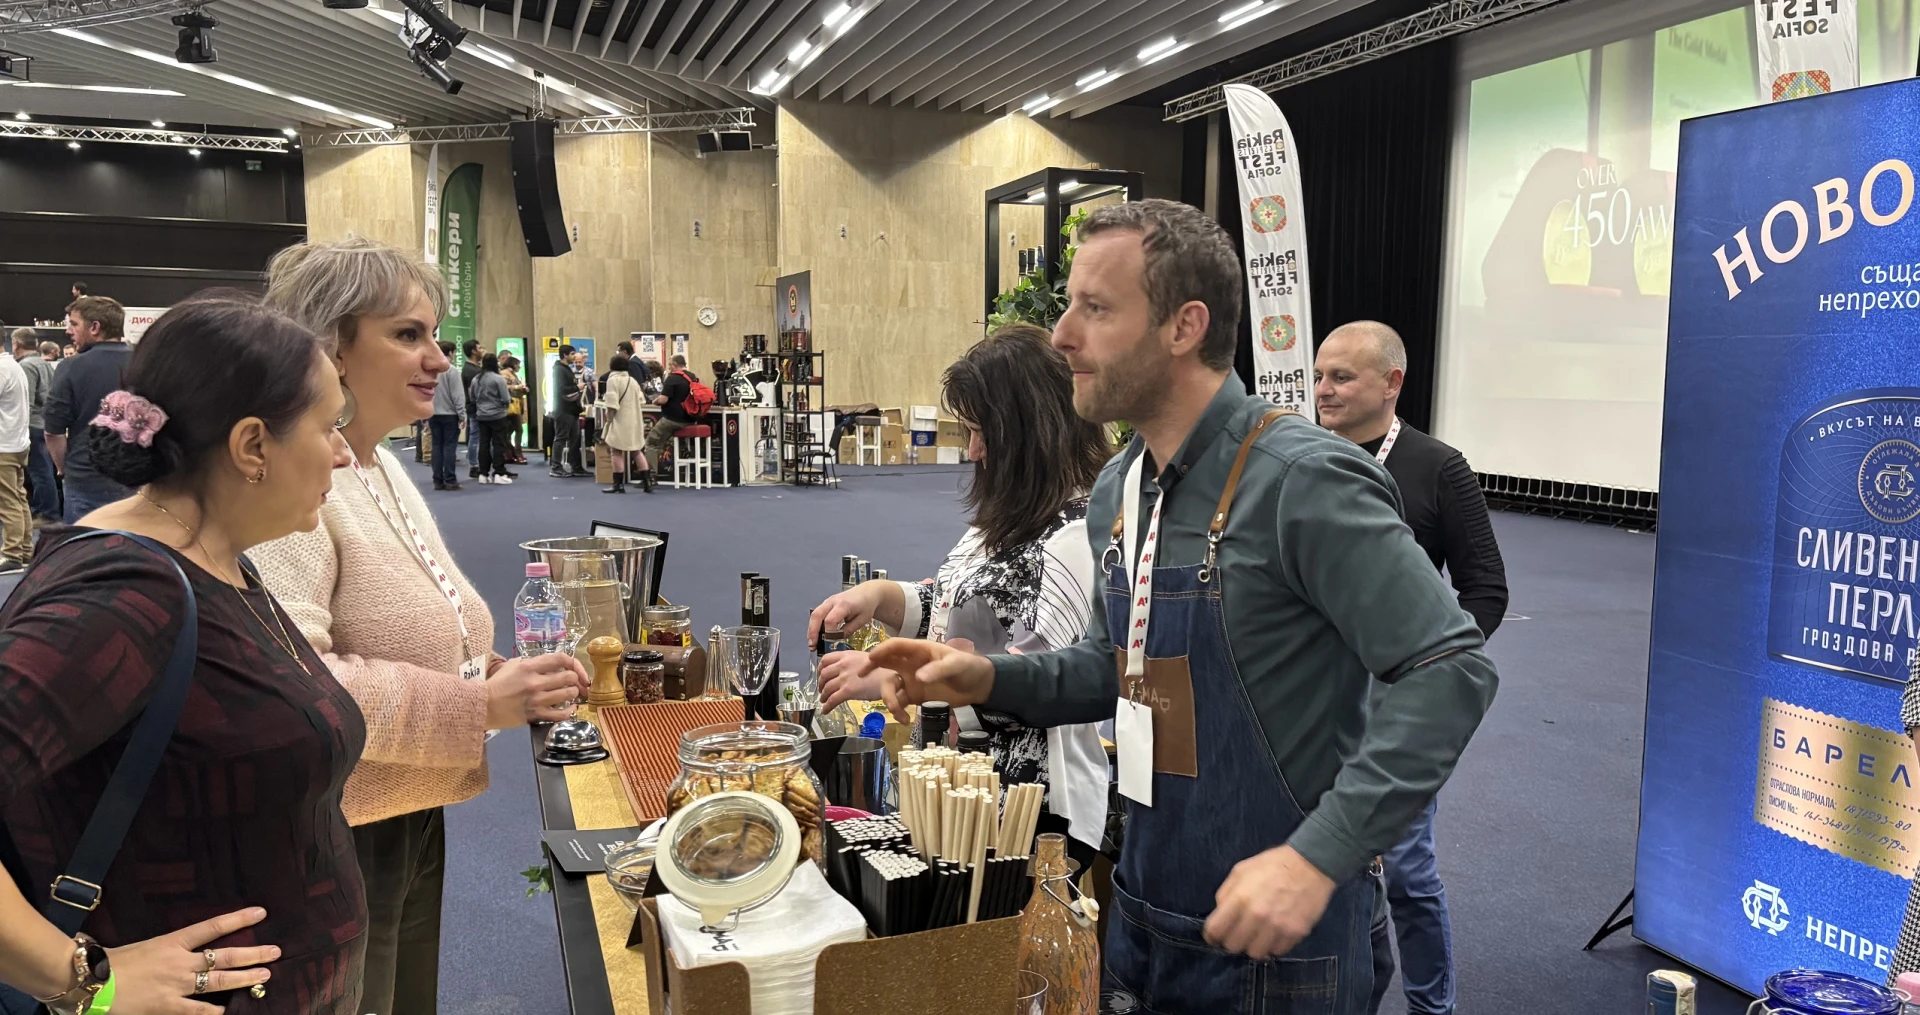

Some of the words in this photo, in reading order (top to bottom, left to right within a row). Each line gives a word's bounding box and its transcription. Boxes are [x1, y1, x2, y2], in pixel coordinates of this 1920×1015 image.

[1576, 164, 1616, 189] OVER
[1563, 188, 1631, 248] 450
[1712, 159, 1915, 301] НОВО
[448, 212, 462, 318] стикери
[1819, 290, 1920, 318] непрехо
[131, 316, 157, 324] ДИО
[1819, 415, 1874, 438] ВКУСЪТ
[1883, 415, 1904, 426] НА
[1797, 527, 1919, 583] СЛИВЕН
[1139, 575, 1149, 585] A1
[1137, 596, 1148, 606] A1
[1828, 582, 1920, 640] ПЕРЛ
[1135, 618, 1146, 628] A1
[1132, 638, 1143, 648] A1
[1803, 627, 1894, 662] ГРОЗДОВА
[463, 666, 480, 680] Rakia
[1773, 727, 1911, 788] БАРЕЛ
[1769, 777, 1800, 798] ОТРАСЛОВА
[1768, 794, 1786, 810] ПИСМО
[1806, 915, 1895, 971] НЕПРЕ
